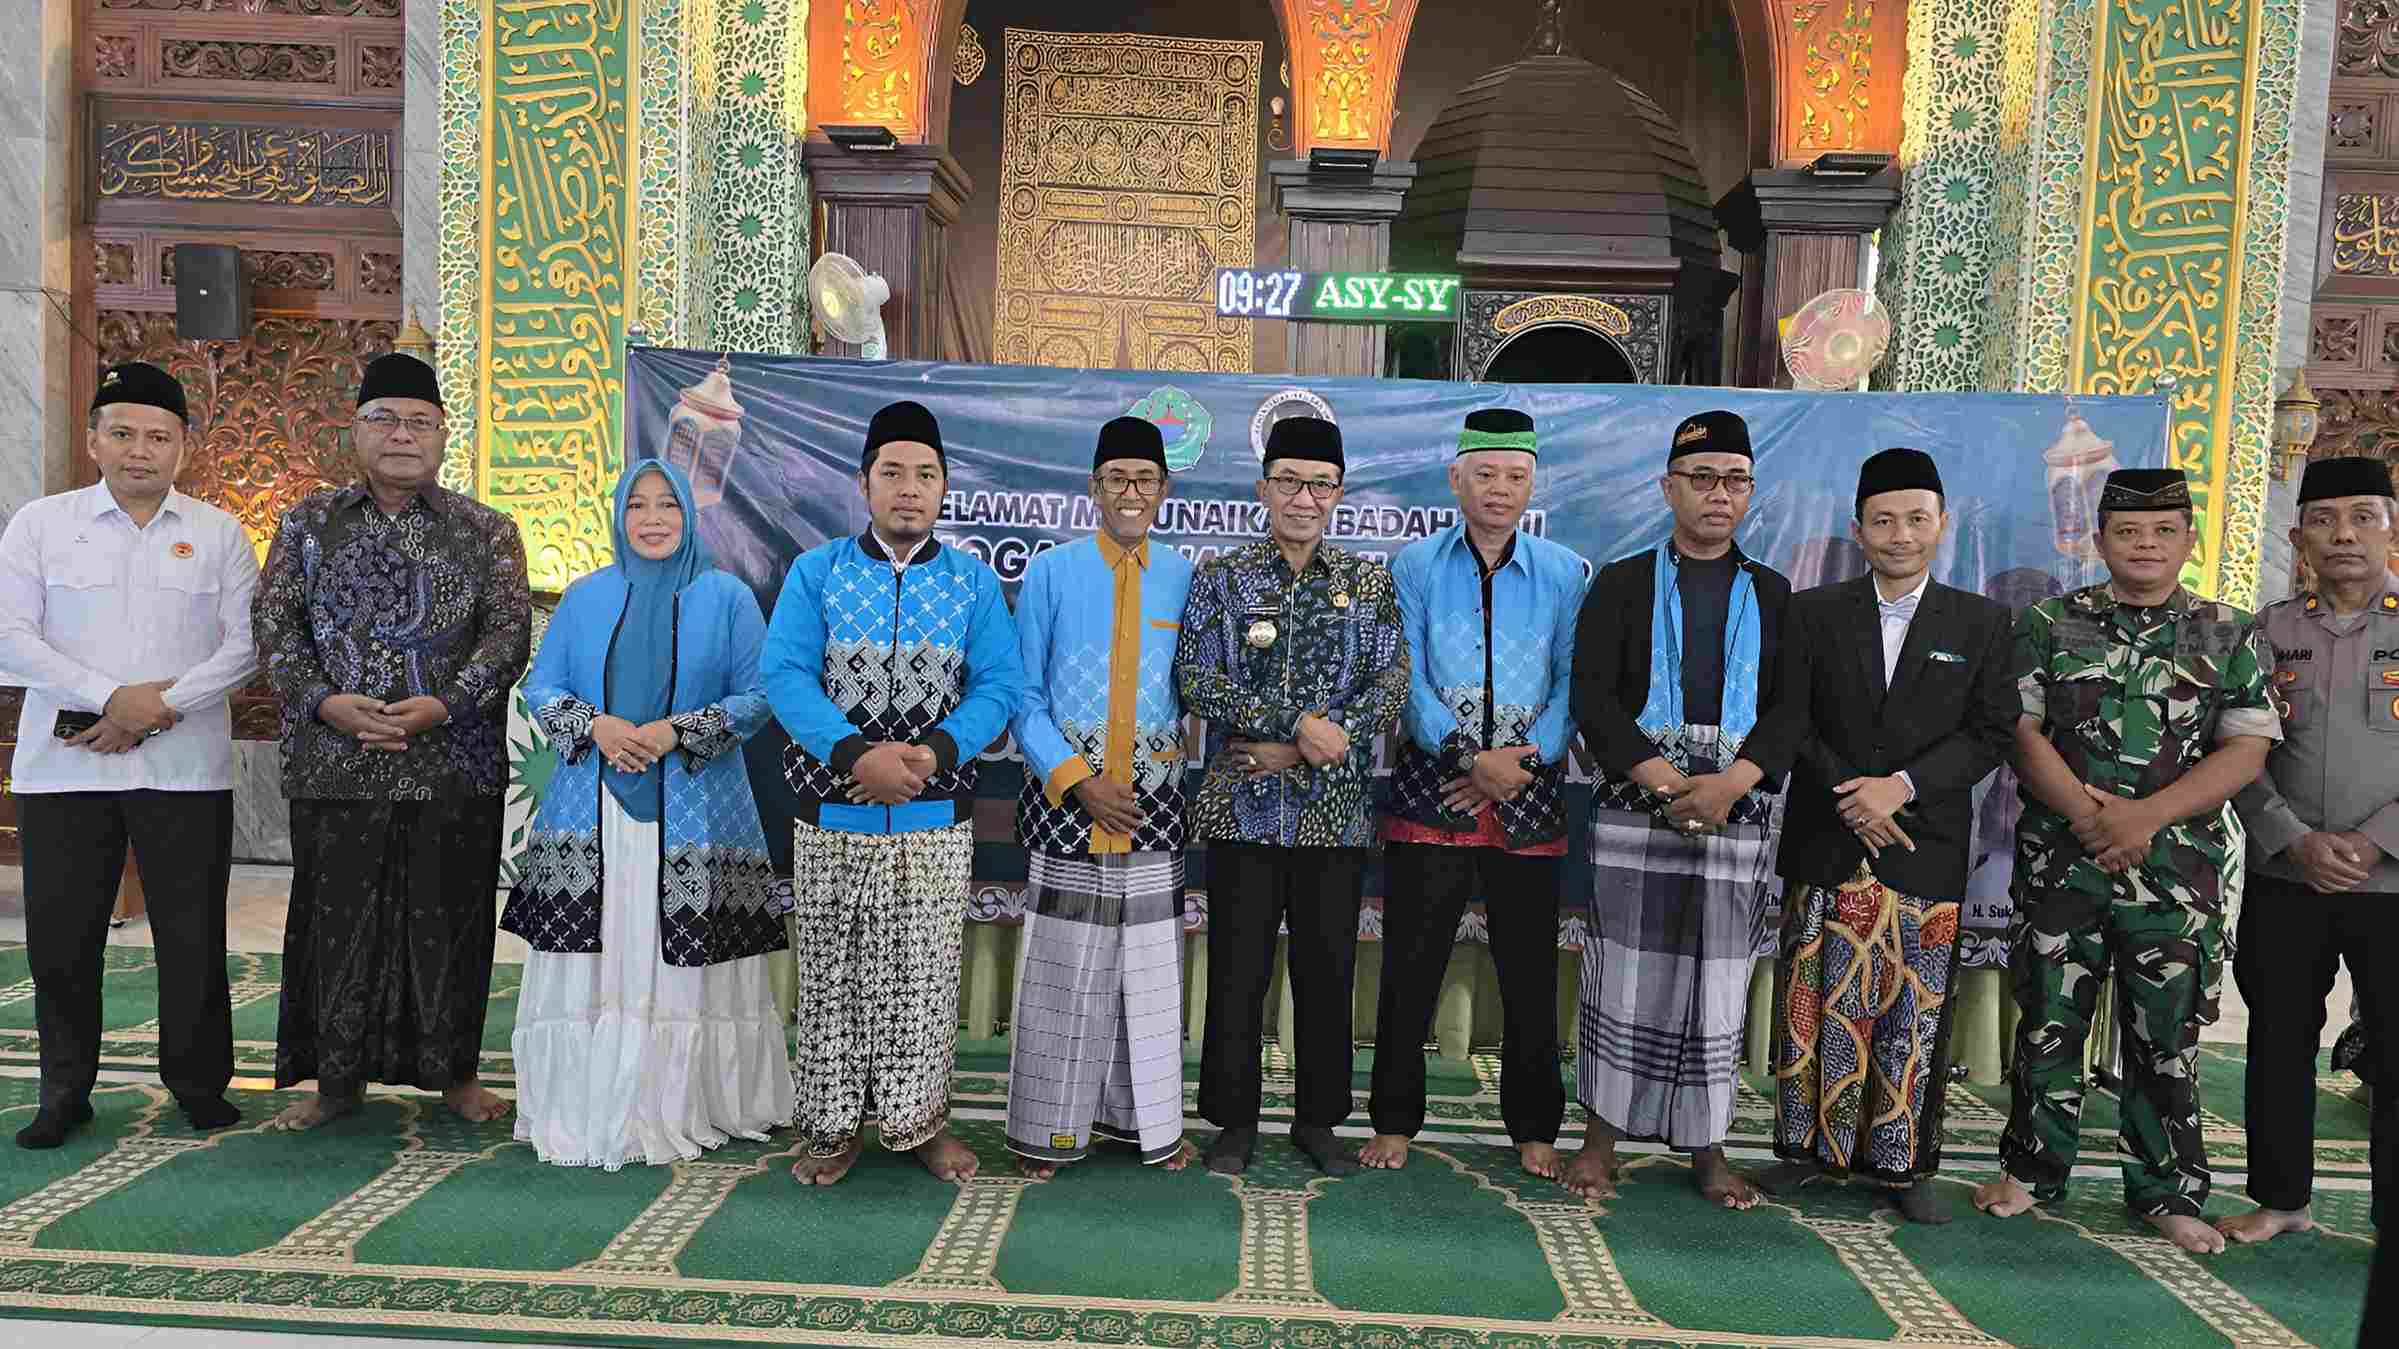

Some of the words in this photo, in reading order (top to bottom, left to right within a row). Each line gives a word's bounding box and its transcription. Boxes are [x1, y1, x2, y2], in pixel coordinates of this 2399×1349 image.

[1218, 270, 1302, 316] 09:27
[1315, 276, 1460, 312] ASY-SY
[935, 490, 1067, 529] ELAMAT
[1988, 903, 2012, 918] Suk
